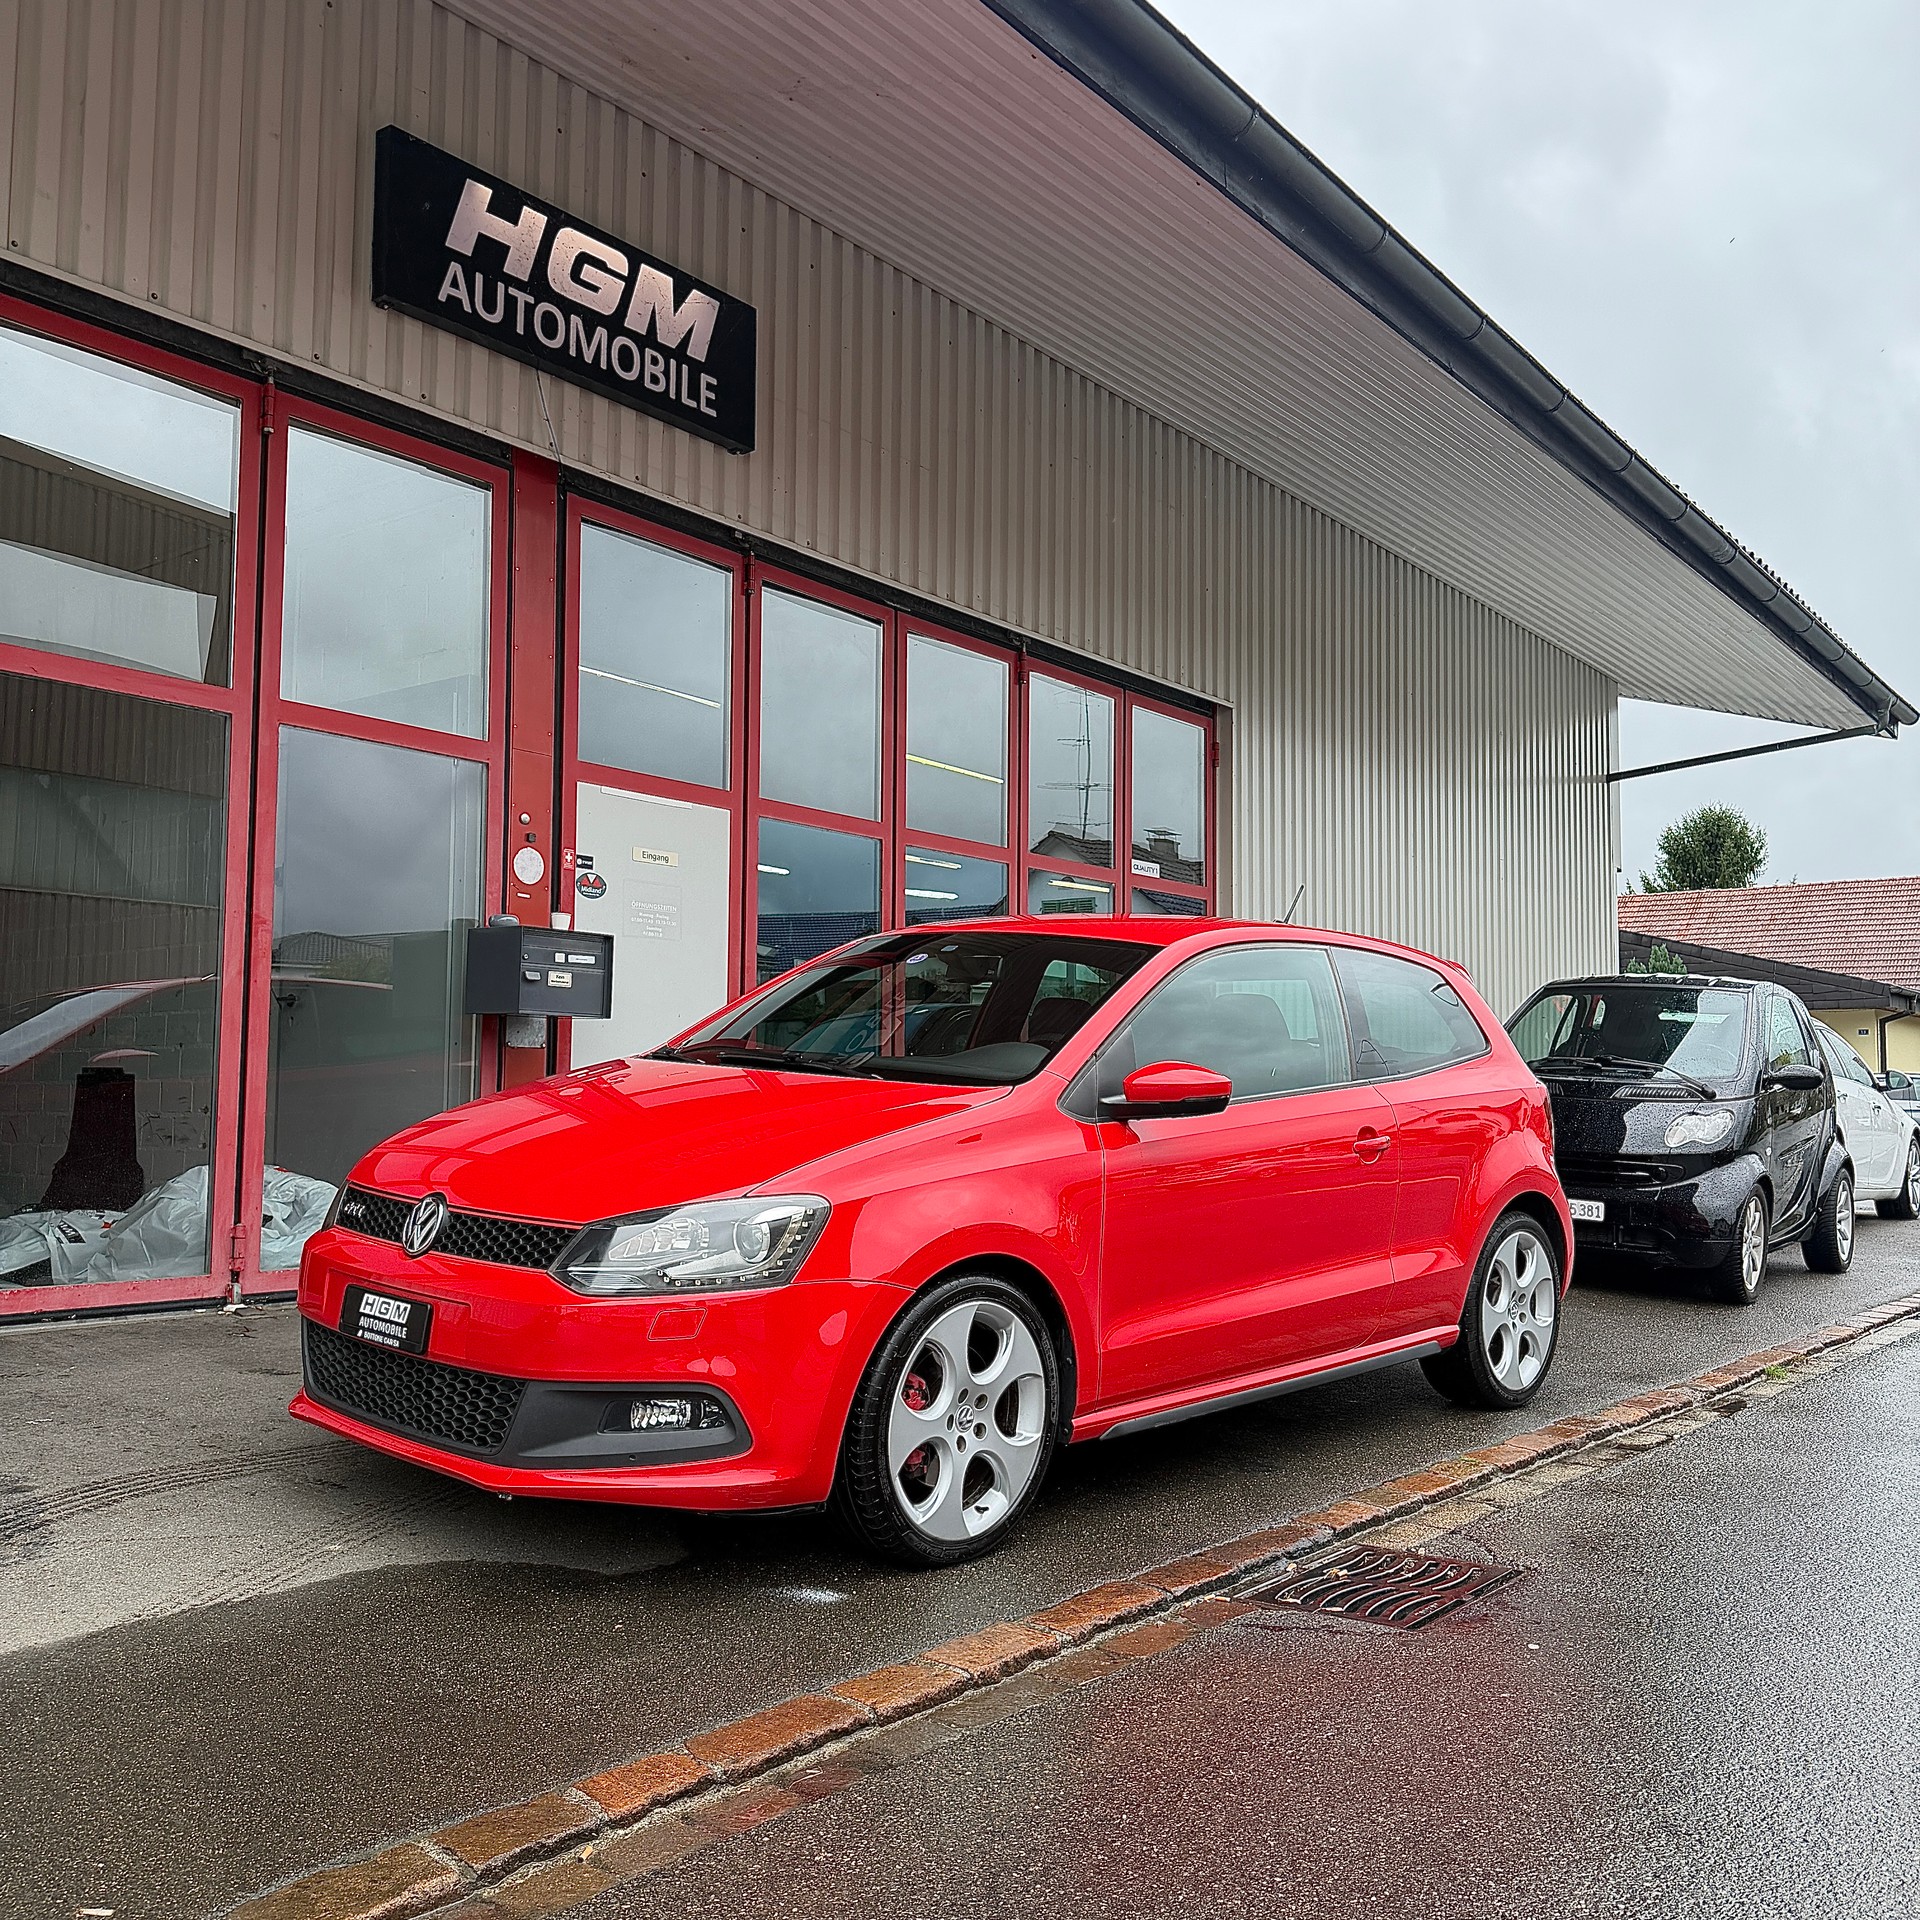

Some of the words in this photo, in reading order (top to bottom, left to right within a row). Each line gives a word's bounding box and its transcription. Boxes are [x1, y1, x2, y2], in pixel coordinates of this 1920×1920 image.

[445, 178, 720, 362] HGM
[437, 262, 718, 418] AUTOMOBILE
[642, 850, 669, 863] Eingang
[360, 1294, 410, 1324] HGM
[359, 1316, 408, 1339] AUTOMOBILE
